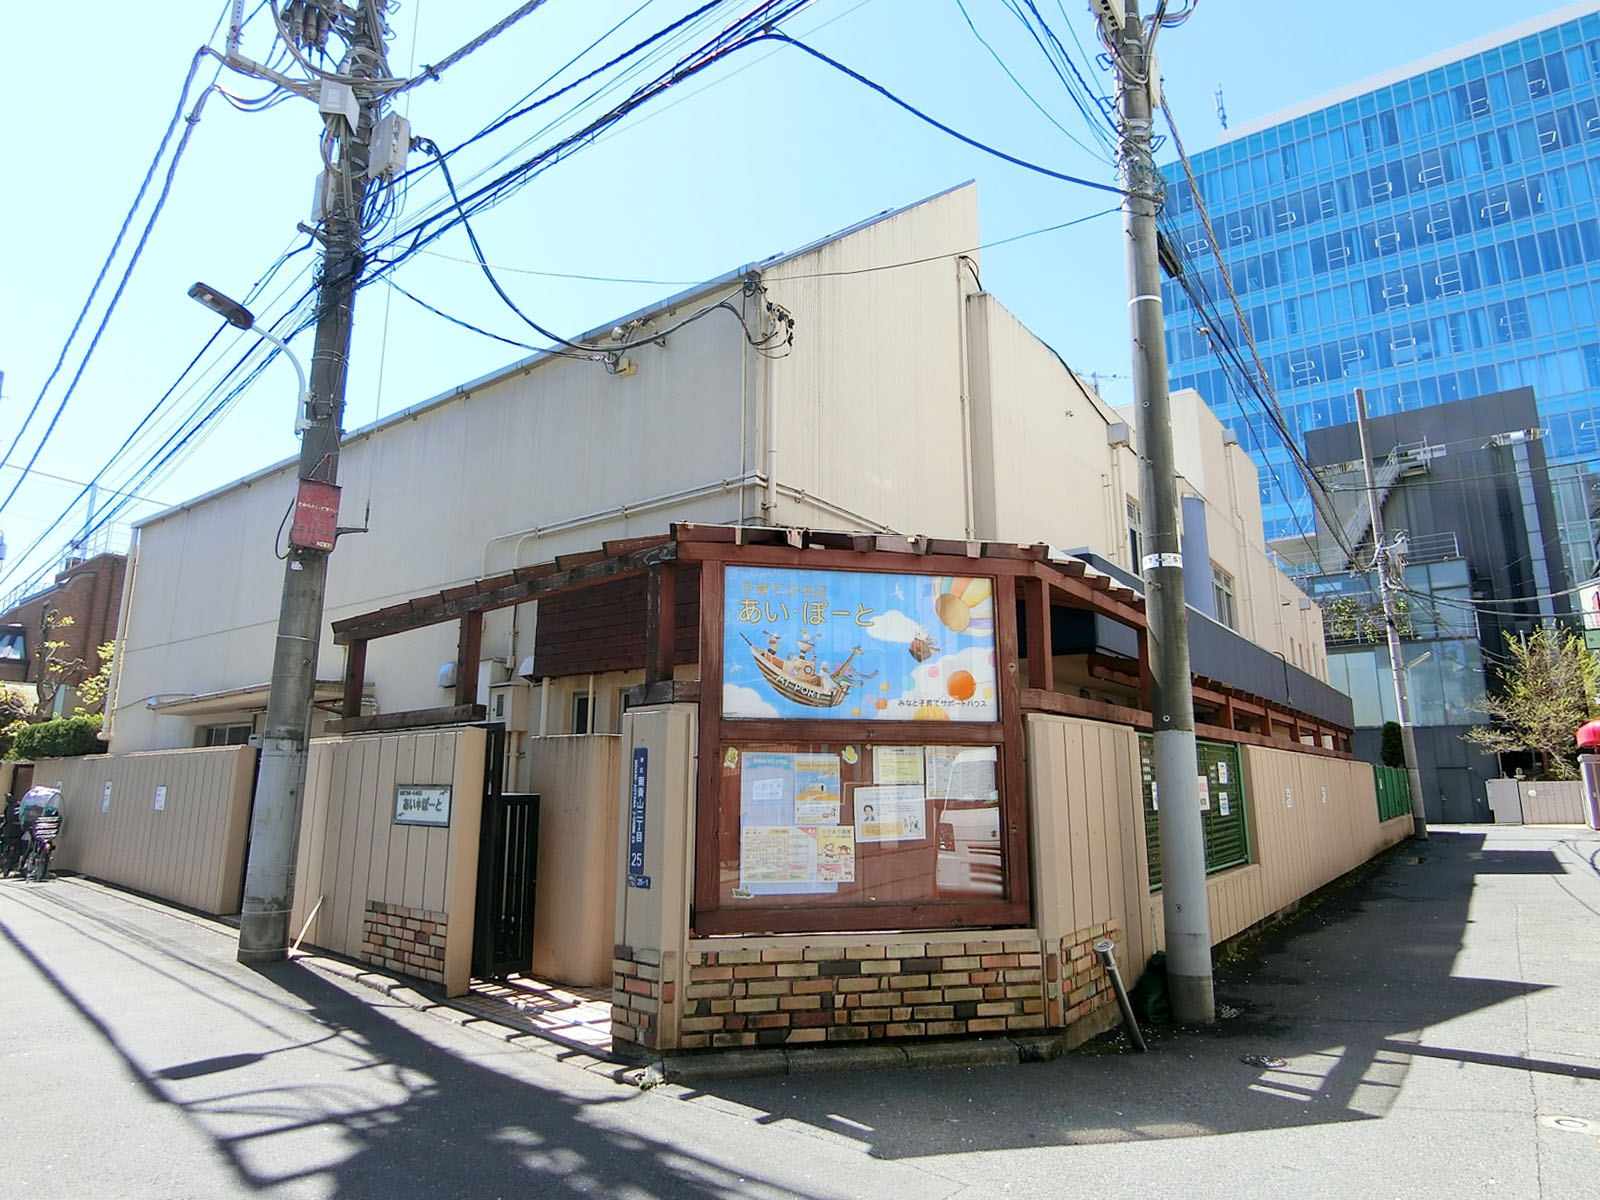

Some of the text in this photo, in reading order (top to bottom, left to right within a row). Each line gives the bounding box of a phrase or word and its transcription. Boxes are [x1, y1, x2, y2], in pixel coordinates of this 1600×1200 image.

[741, 581, 827, 598] 子育てひろば
[738, 597, 875, 627] あい・ぽーと
[631, 852, 642, 867] 25
